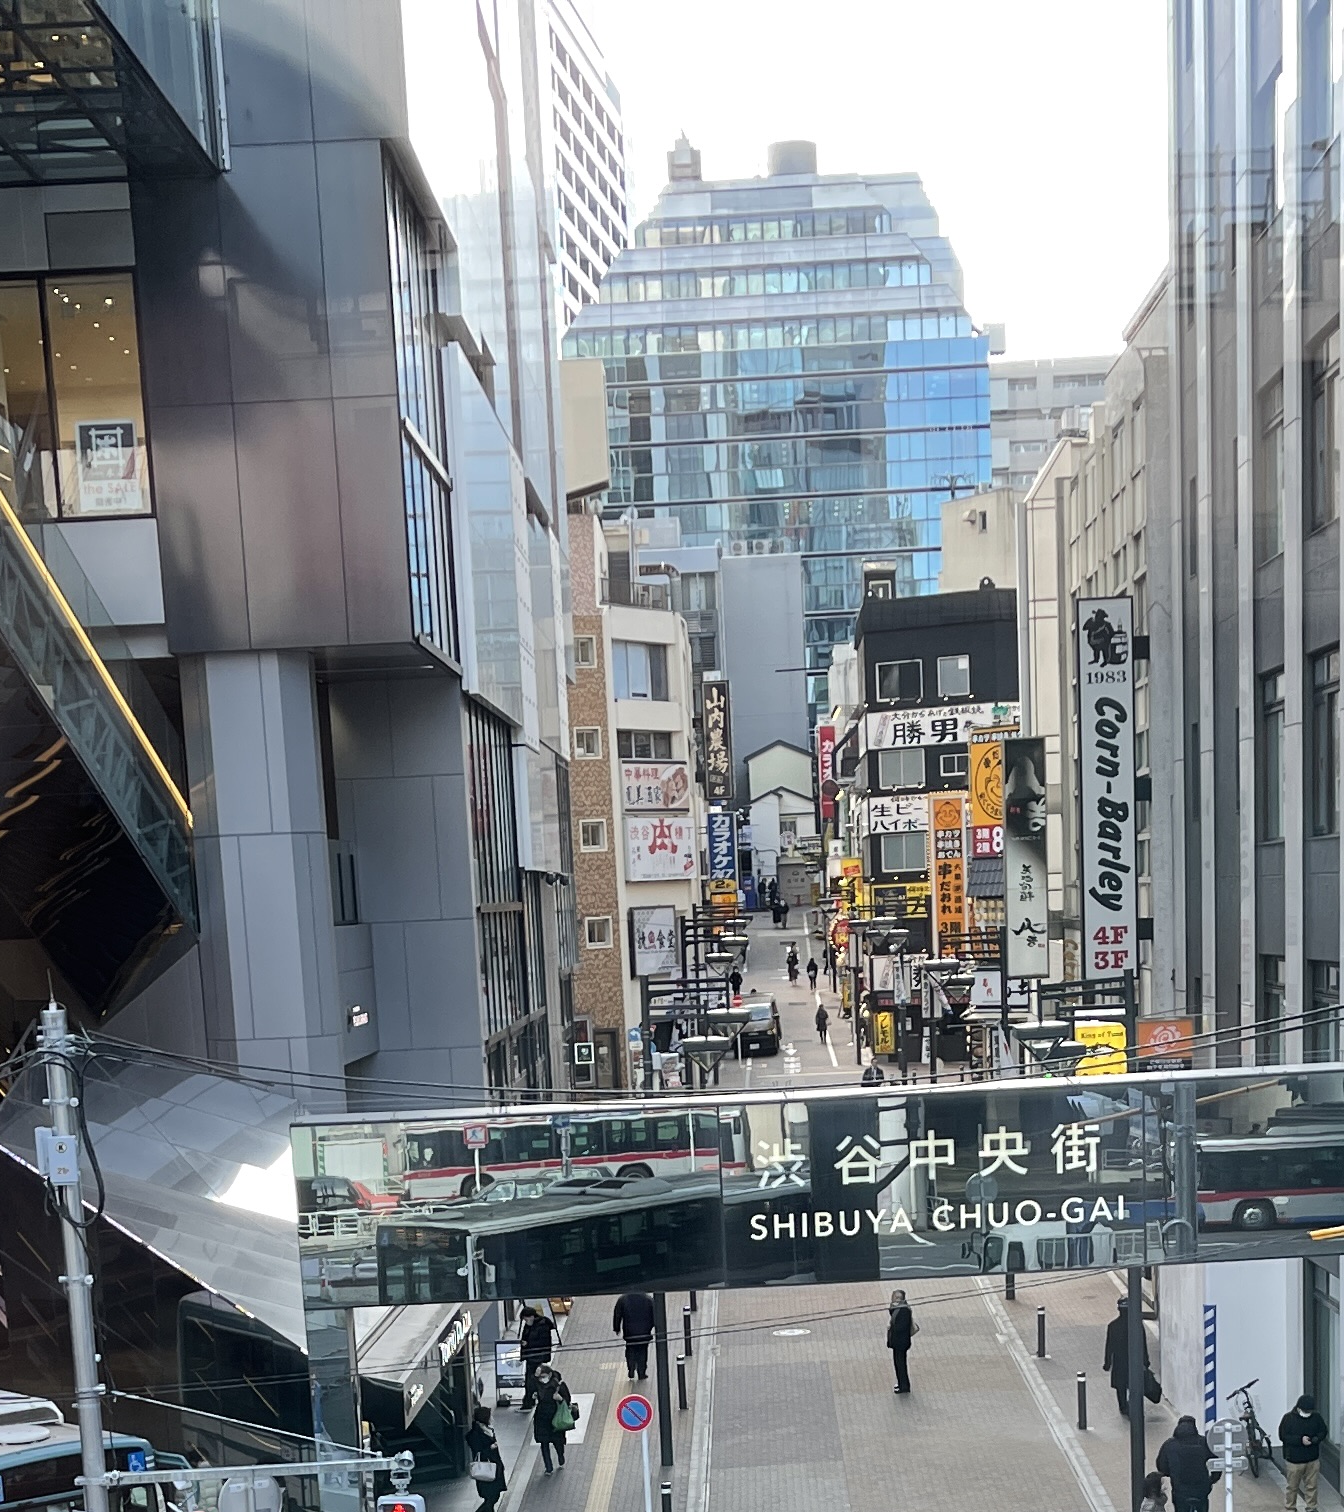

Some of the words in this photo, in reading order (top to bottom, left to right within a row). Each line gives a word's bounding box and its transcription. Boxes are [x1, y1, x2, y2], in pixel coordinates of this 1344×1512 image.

[1086, 671, 1127, 685] 1983
[706, 686, 729, 774] 山内農場
[891, 717, 959, 746] 勝男
[871, 803, 926, 818] 生ビー
[1088, 696, 1131, 911] Corn-Barley
[938, 861, 953, 915] 串だおれ
[1092, 925, 1129, 946] 4F
[1093, 950, 1129, 970] 3F
[756, 1122, 1101, 1188] 渋谷中央街
[750, 1207, 915, 1241] SHIBUYA
[932, 1194, 1126, 1233] CHUO-GAI
